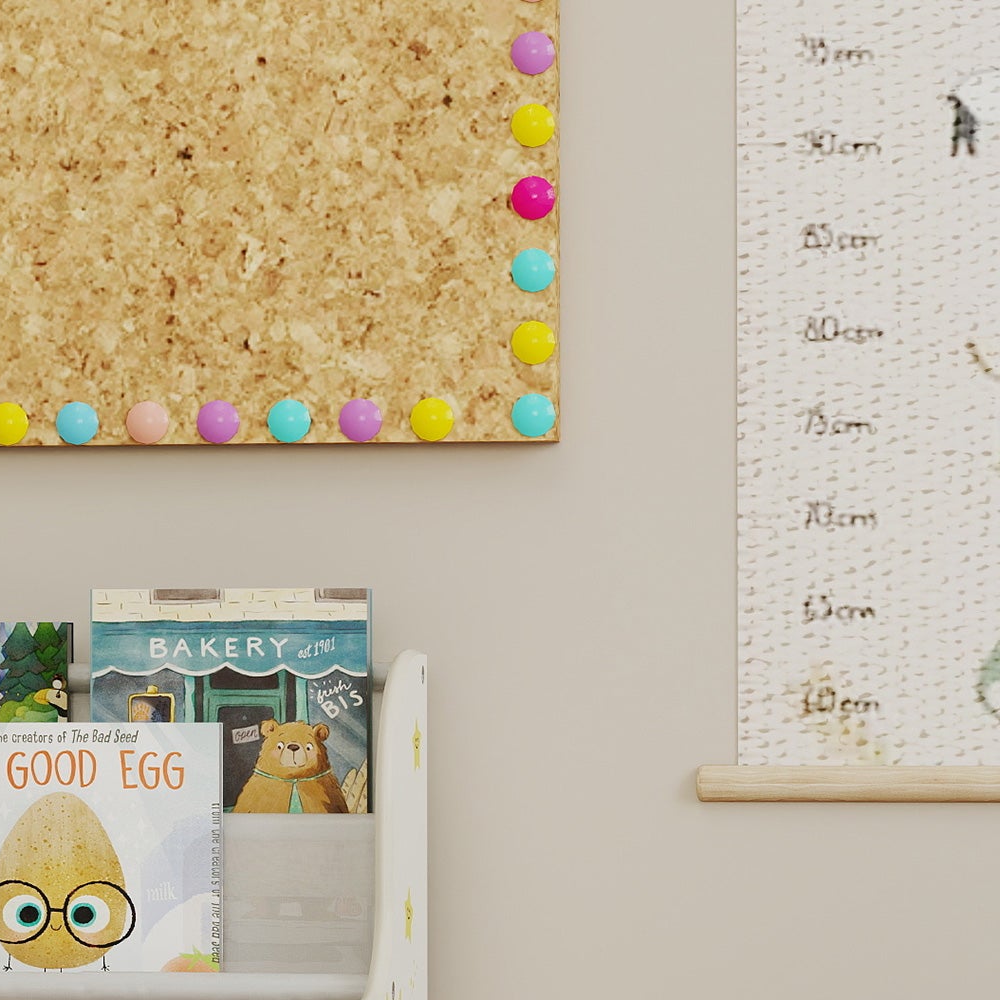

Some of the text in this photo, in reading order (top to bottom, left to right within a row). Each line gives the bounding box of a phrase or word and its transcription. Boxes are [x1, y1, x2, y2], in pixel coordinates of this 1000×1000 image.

[150, 637, 289, 659] BAKERY
[317, 680, 352, 703] fresh
[321, 690, 364, 719] BIS
[12, 732, 53, 744] creators
[57, 731, 67, 743] of
[72, 729, 88, 743] The
[92, 729, 111, 743] Bad
[114, 729, 139, 743] Seed
[234, 729, 258, 741] open
[7, 749, 97, 790] GOOD
[120, 749, 185, 791] EGG
[146, 881, 178, 902] milk
